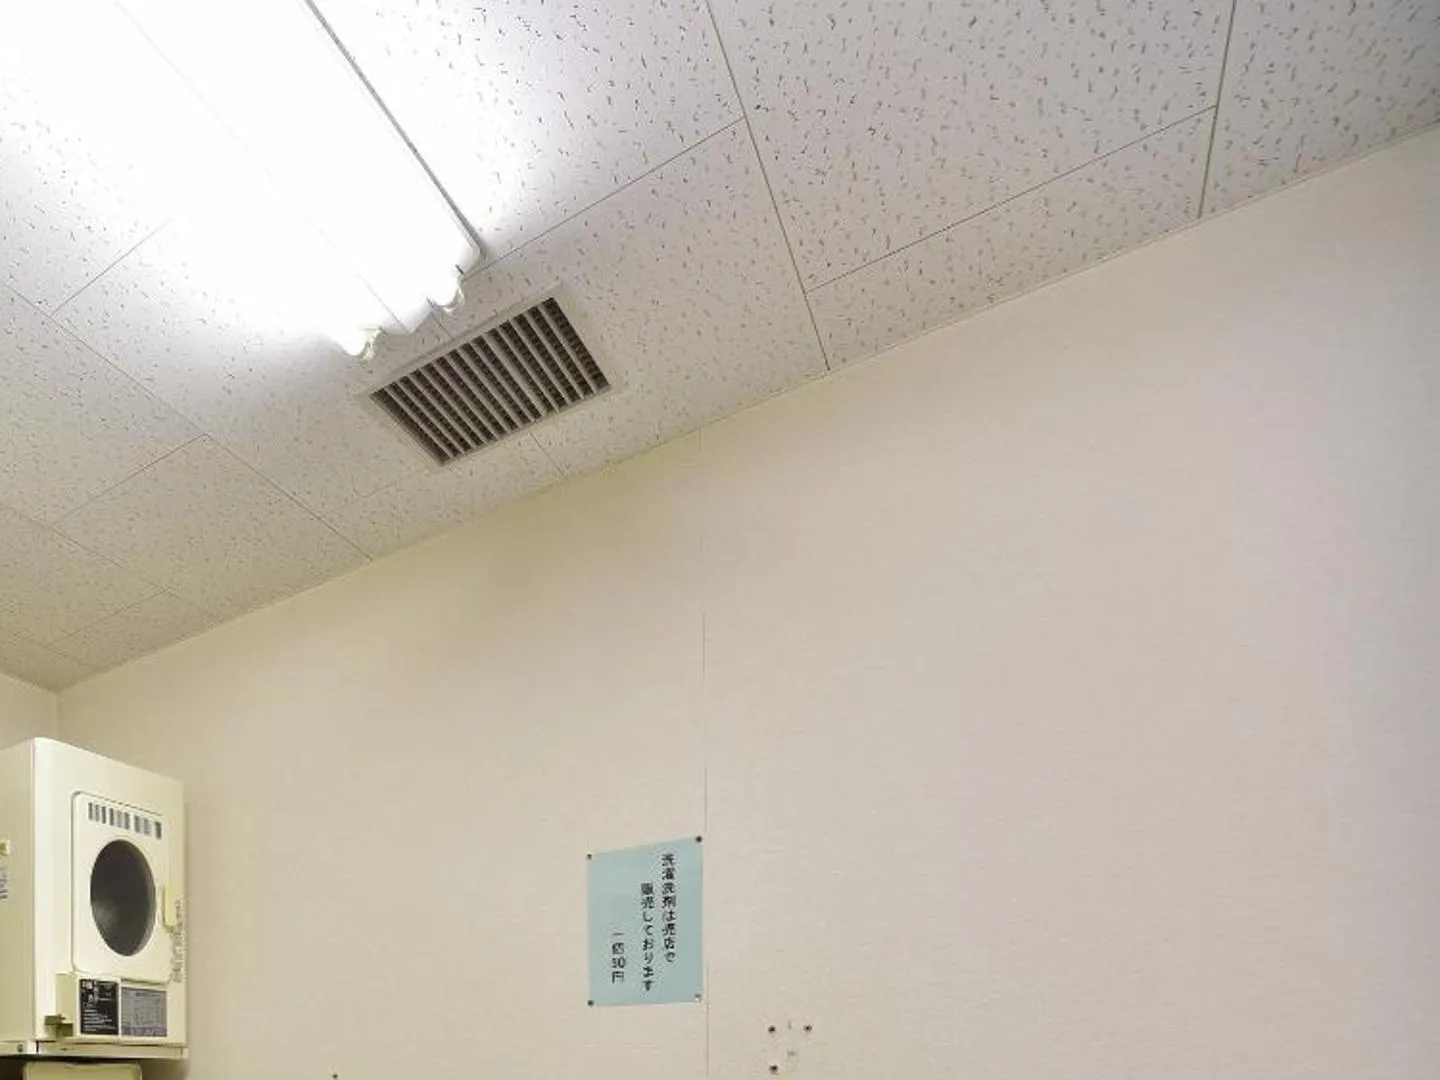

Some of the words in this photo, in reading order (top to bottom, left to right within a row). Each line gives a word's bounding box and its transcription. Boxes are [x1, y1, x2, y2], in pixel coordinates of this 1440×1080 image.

[641, 883, 655, 991] 販売しております
